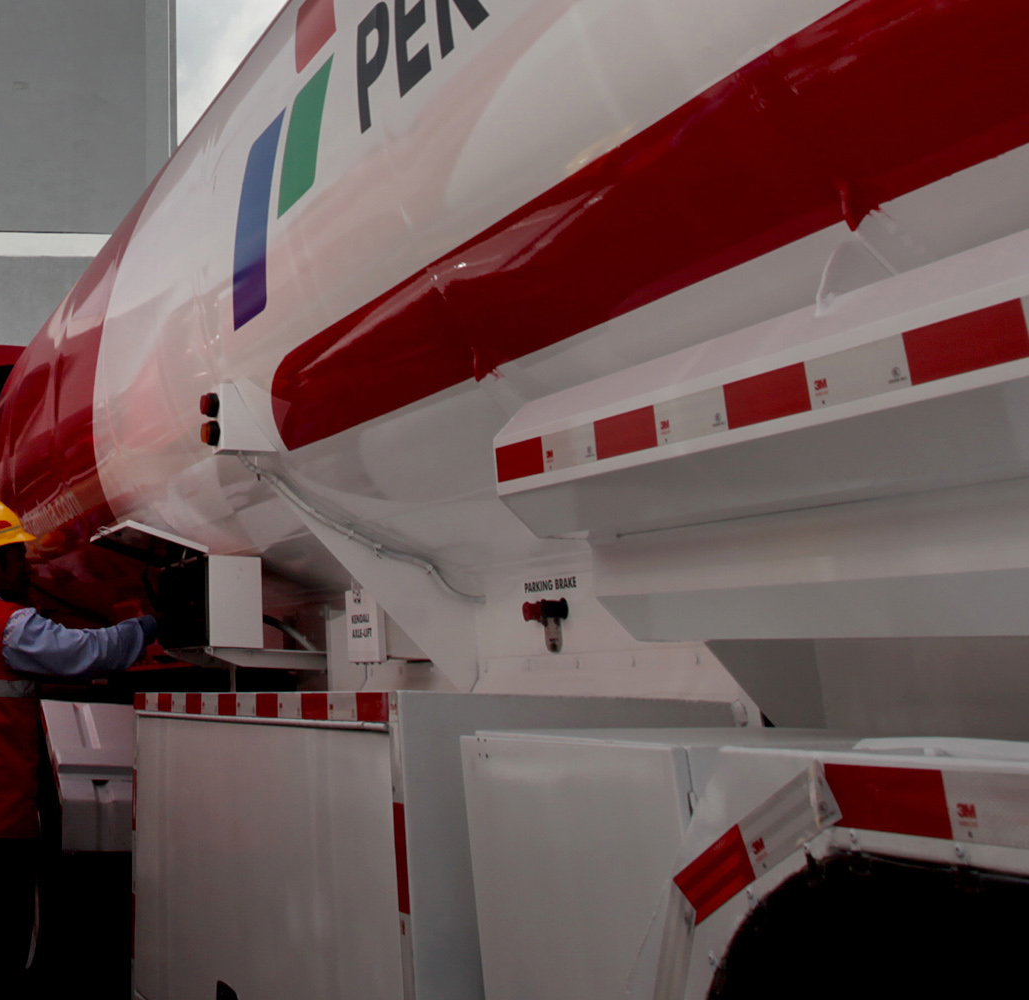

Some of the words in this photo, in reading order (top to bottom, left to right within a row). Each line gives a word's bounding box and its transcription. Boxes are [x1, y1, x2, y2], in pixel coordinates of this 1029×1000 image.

[814, 378, 828, 391] 3M
[524, 580, 553, 593] PARKING
[554, 576, 577, 590] BRAKE
[956, 802, 977, 818] 3M
[751, 837, 765, 855] 3M
